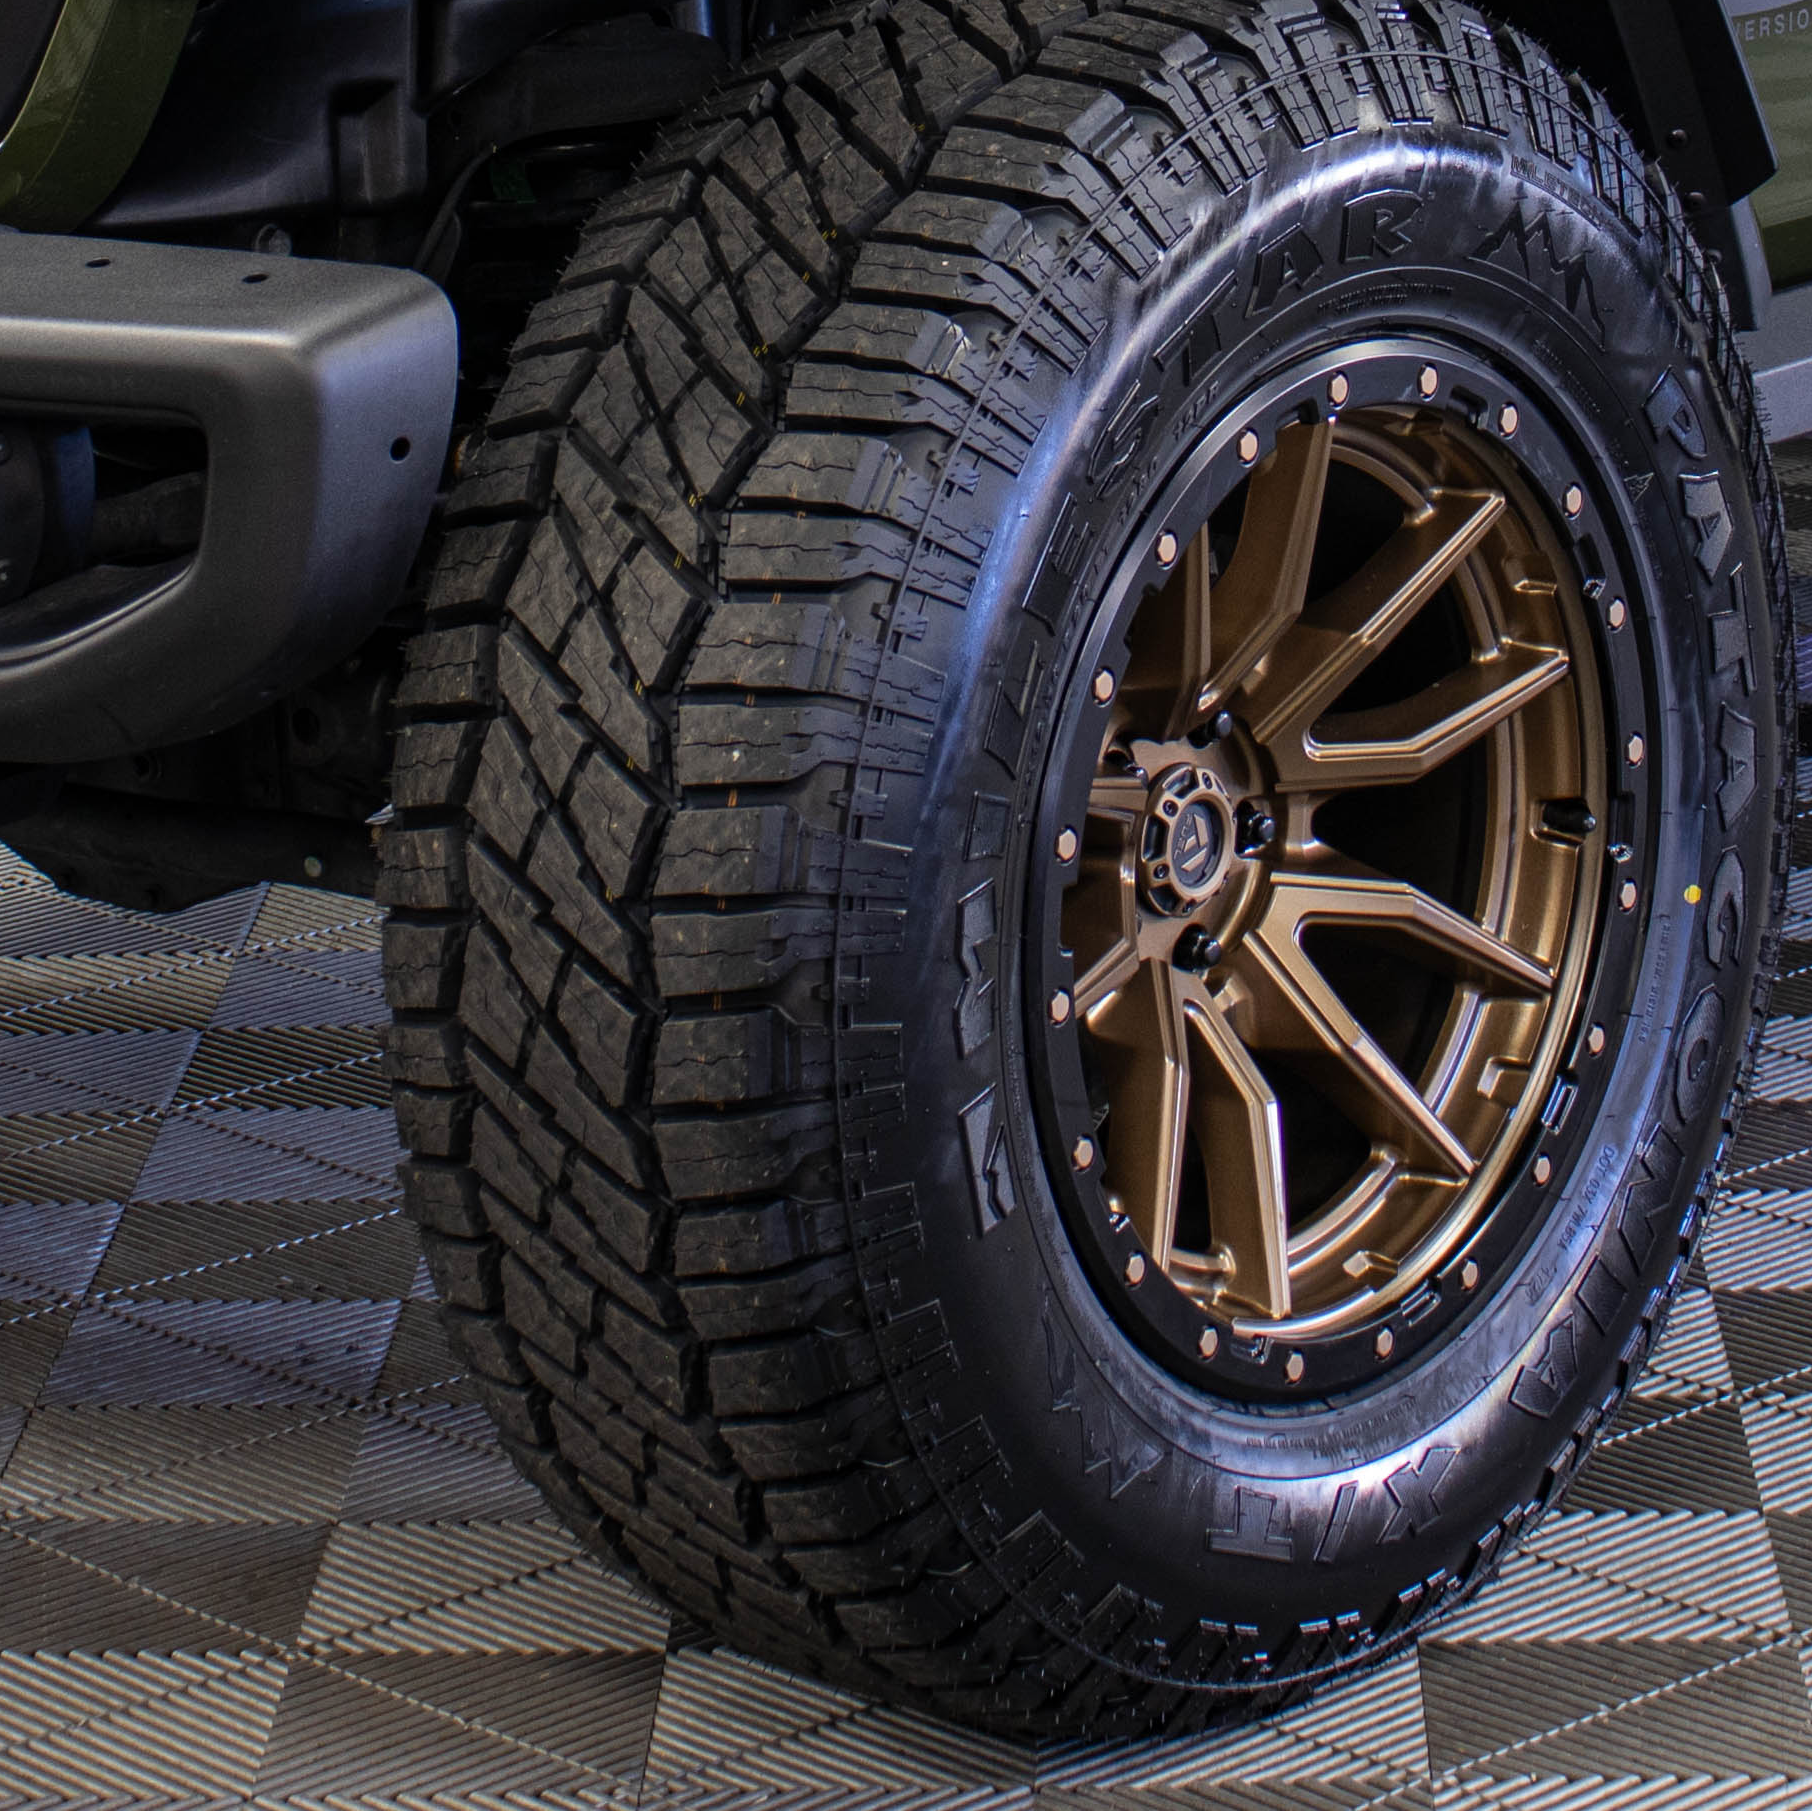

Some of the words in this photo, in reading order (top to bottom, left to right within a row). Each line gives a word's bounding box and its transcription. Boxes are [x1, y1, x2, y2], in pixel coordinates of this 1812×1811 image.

[954, 189, 1425, 1059] MILESTAR
[1510, 365, 1757, 1418] PATAGONIA
[1599, 1145, 1614, 1177] DOT
